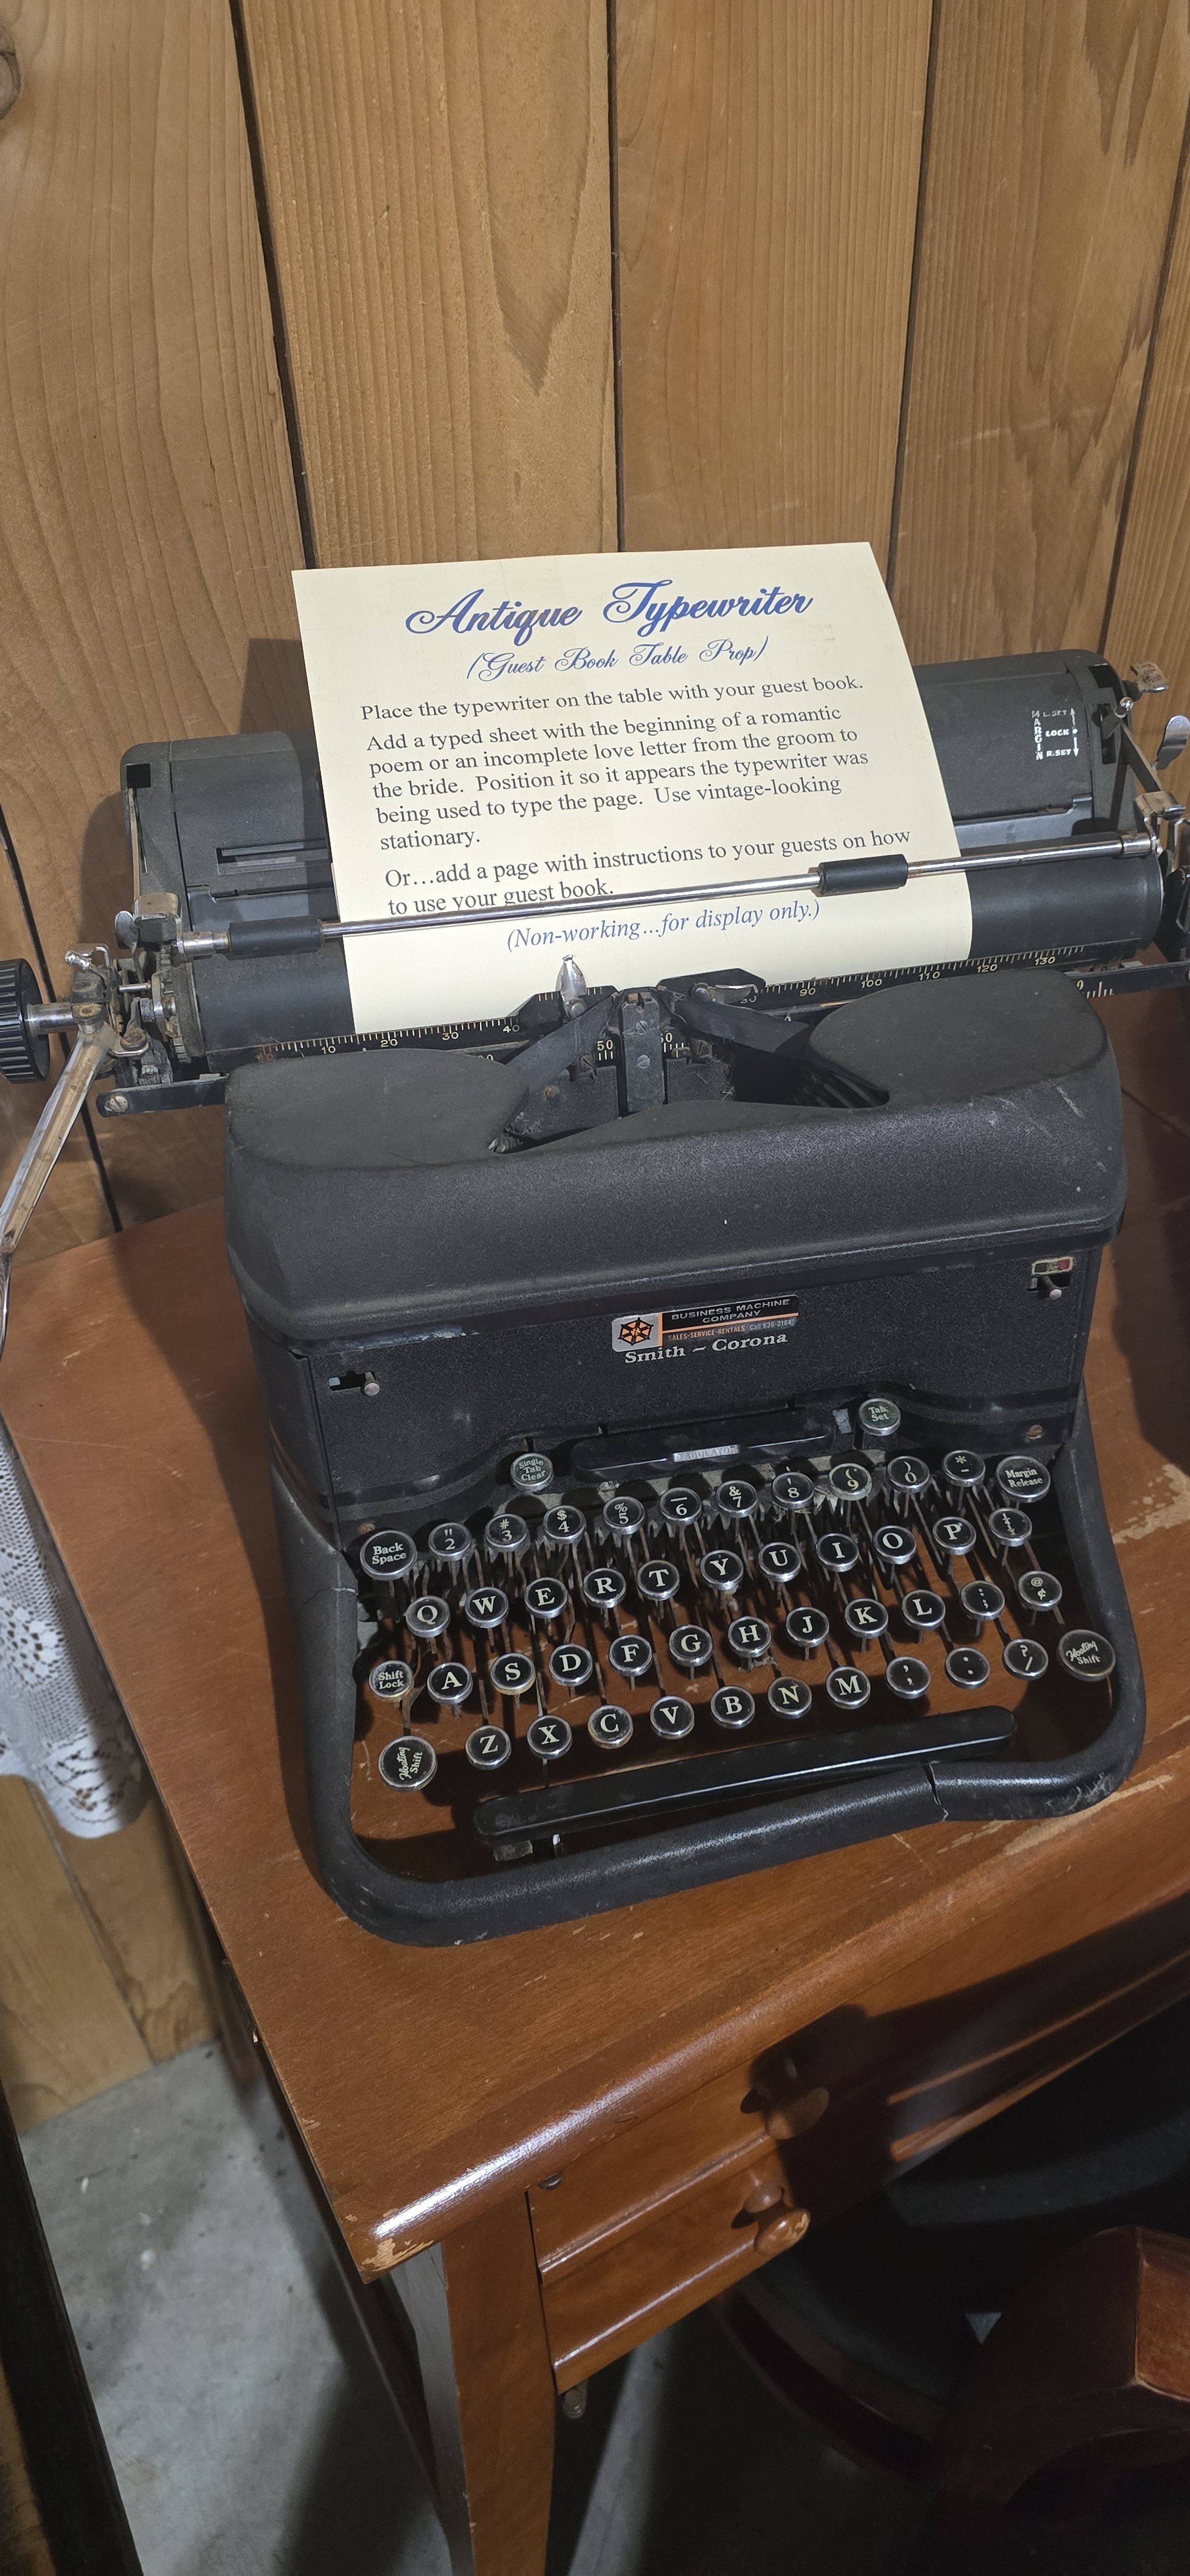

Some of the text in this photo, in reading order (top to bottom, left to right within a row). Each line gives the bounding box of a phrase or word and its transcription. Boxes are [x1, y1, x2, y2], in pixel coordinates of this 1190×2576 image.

[406, 579, 813, 646] Antique Typewriter
[466, 636, 769, 682] (Guest Book Table Prop)
[360, 676, 863, 720] Place the typewriter on the table with your guest book.
[367, 706, 841, 750] Add a typed sheet with the beginning of a romantic
[1046, 729, 1070, 737] LOCK
[369, 729, 857, 778] poem or an incomplete love letter from the groom to
[372, 753, 868, 798] the bride. Position it so it appears the typewriter was
[376, 776, 841, 825] being used to type the page. Use vintage-looking
[381, 830, 480, 850] stationary.
[477, 866, 487, 878] a
[494, 861, 539, 883] page
[544, 854, 588, 872] with
[593, 846, 703, 868] instructions
[708, 845, 726, 858] to
[732, 843, 774, 861] your
[782, 837, 837, 857] guests
[843, 836, 865, 849] on
[870, 830, 910, 846] how
[388, 878, 613, 915] to use your guest book.
[696, 906, 763, 930] display
[770, 899, 819, 922] only.)
[321, 1046, 336, 1054] 10
[381, 1039, 397, 1047] 20
[443, 1032, 458, 1040] 30
[800, 988, 815, 996] 90
[862, 979, 882, 988] 100
[919, 972, 940, 982] 110
[977, 964, 997, 973] 120
[1035, 956, 1055, 965] 130
[597, 1040, 613, 1051] 50
[672, 1299, 790, 1320] BUSINESS MACHINE
[702, 1310, 761, 1323] COMPANY
[749, 1322, 761, 1331] Call
[625, 1346, 686, 1363] Smith
[712, 1333, 788, 1352] Corona
[871, 1413, 890, 1422] Set
[518, 1458, 544, 1469] Single
[523, 1465, 542, 1473] Tab
[521, 1470, 545, 1481] Clear
[1005, 1468, 1038, 1478] Margin
[1007, 1478, 1043, 1487] Release
[943, 1522, 962, 1540] P
[373, 1542, 404, 1555] Back
[832, 1542, 845, 1558] I
[883, 1533, 902, 1549] O
[372, 1552, 407, 1565] Space
[710, 1558, 728, 1575] Y
[769, 1550, 788, 1566] U
[595, 1578, 616, 1594] R
[649, 1569, 669, 1587] T
[472, 1596, 496, 1614] W
[536, 1588, 555, 1606] E
[417, 1606, 437, 1624] Q
[854, 1607, 877, 1624] K
[912, 1599, 932, 1615] L
[739, 1624, 760, 1643] H
[803, 1616, 812, 1633] J
[681, 1634, 701, 1652] G
[621, 1644, 639, 1662] F
[1077, 1654, 1101, 1664] Shift
[505, 1662, 520, 1681] S
[559, 1654, 581, 1671] D
[377, 1670, 404, 1681] Shift
[379, 1678, 405, 1690] Lock
[442, 1672, 463, 1690] A
[835, 1675, 862, 1695] M
[778, 1686, 799, 1704] N
[723, 1696, 742, 1714] B
[601, 1713, 618, 1732] C
[660, 1706, 678, 1724] V
[538, 1725, 559, 1744] X
[480, 1735, 498, 1754] Z
[410, 1752, 423, 1774] Shift
